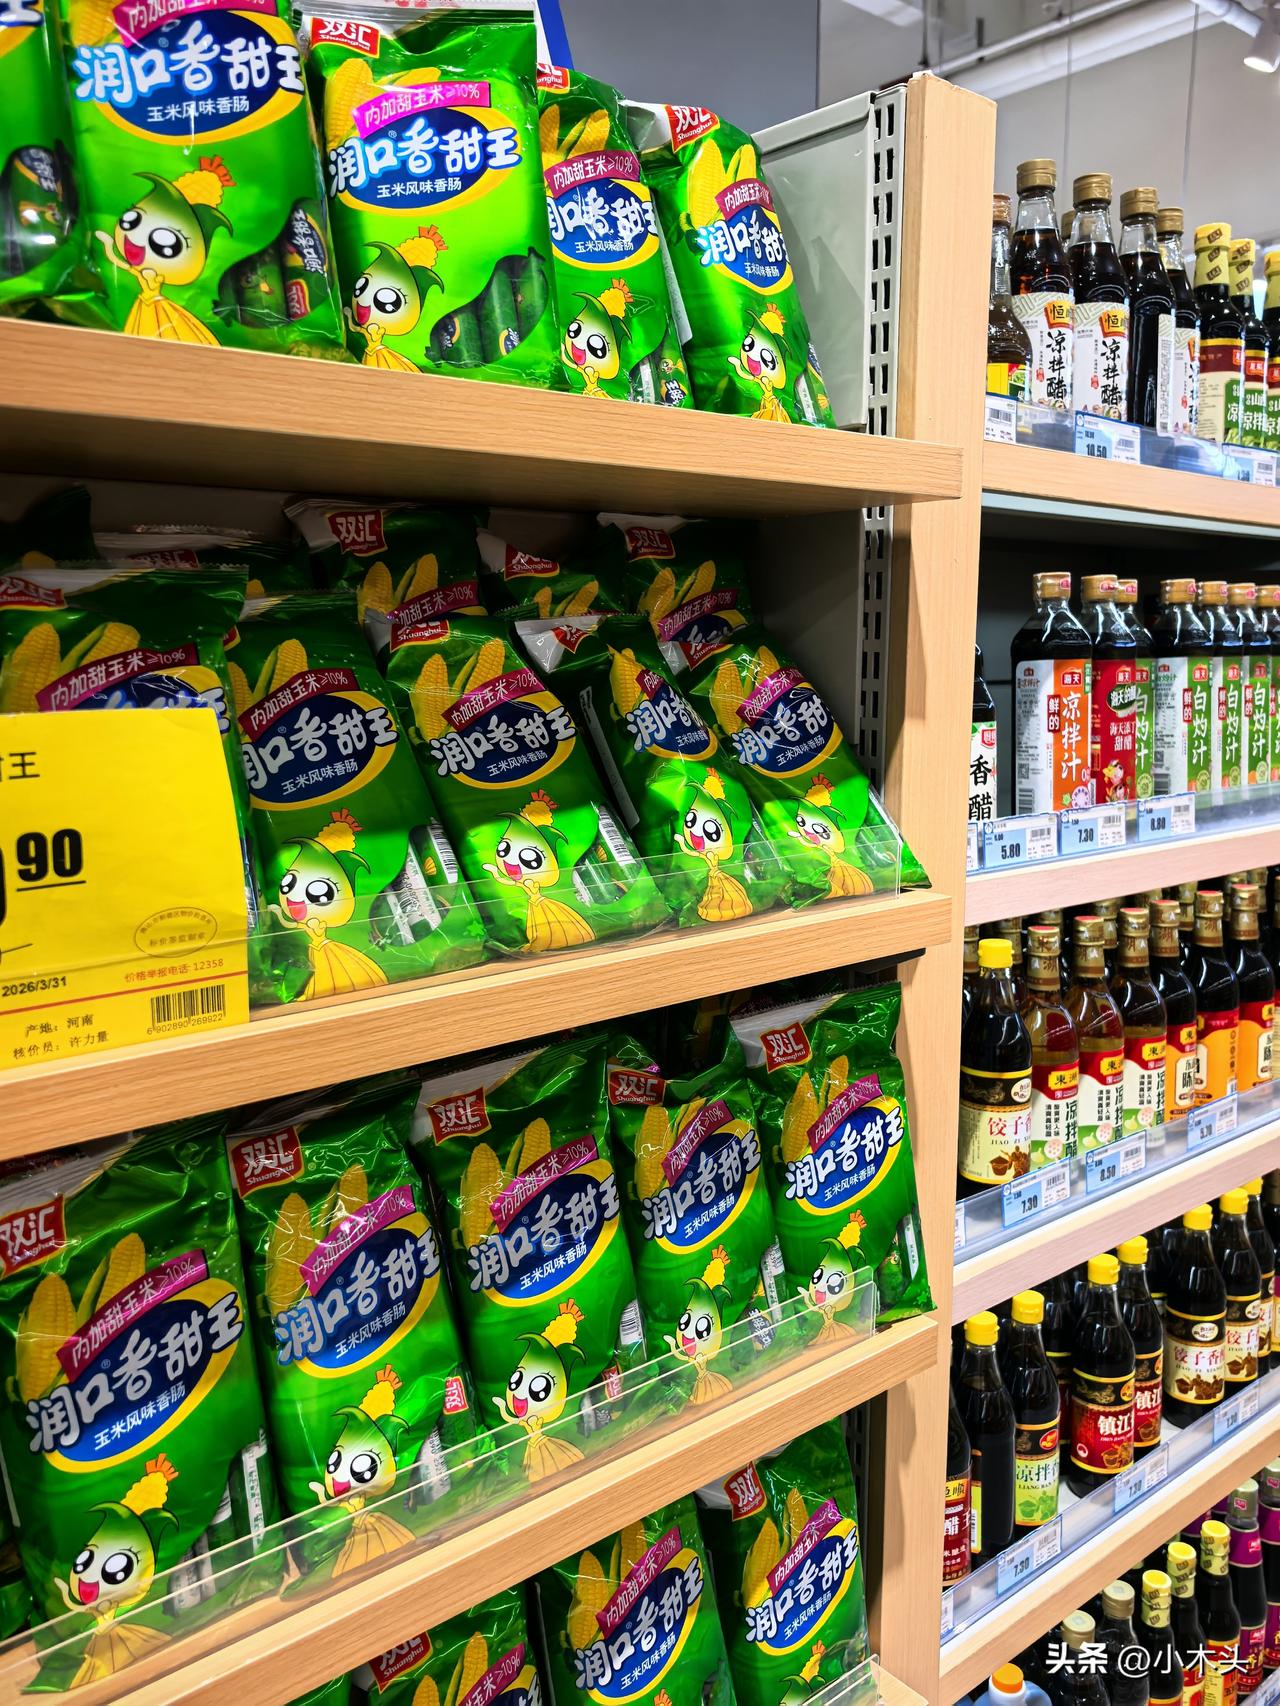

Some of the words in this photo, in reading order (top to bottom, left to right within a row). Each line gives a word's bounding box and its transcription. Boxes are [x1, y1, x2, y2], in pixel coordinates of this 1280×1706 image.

[319, 18, 371, 46] 双汇
[75, 20, 304, 103] 润口香甜王
[147, 96, 250, 123] 玉米风味香肠
[674, 105, 711, 133] 双汇
[677, 120, 712, 142] Shuanghui
[329, 117, 522, 197] 润口香甜王
[553, 157, 634, 190] 内加甜玉米≥10%
[377, 177, 462, 199] 玉米风味香肠
[574, 239, 634, 254] 玉米风味香肠
[697, 210, 790, 265] 润口香甜
[744, 262, 780, 278] 玉米风味香肠
[1045, 329, 1068, 400] 凉拌醋
[1100, 338, 1122, 406] 凉拌醋
[335, 513, 377, 544] 双汇
[633, 529, 667, 548] 双汇
[398, 625, 442, 641] Shuanghui
[51, 651, 187, 712] 内加甜玉米≥10%
[250, 671, 349, 732] 内加甜玉米≥10%
[452, 672, 538, 726] 内加甜玉米≥10%
[732, 694, 830, 766] 润口香甜
[1048, 696, 1060, 731] 鲜的
[1192, 685, 1208, 767] 白灼汁
[1225, 683, 1239, 763] 白灼汁
[1252, 682, 1266, 759] 白灼汁
[431, 706, 577, 777] 润口香甜王
[775, 734, 825, 767] 玉米风味香肠
[1060, 691, 1082, 782] 凉拌汁
[0, 751, 40, 781] 王
[280, 757, 359, 796] 玉米风味香肠
[486, 750, 548, 777] 玉米风味香肠
[968, 754, 992, 821] 香醋
[1001, 843, 1021, 860] 5.80
[1078, 828, 1094, 844] 7.30
[2, 976, 67, 997] 2026/3/31
[124, 964, 190, 983] 价格举报电话
[193, 959, 224, 972] 12358
[66, 1014, 94, 1028] 河南
[146, 1027, 153, 1036] 6
[156, 1019, 188, 1034] 902890
[191, 1013, 223, 1028] 269922
[767, 1028, 803, 1058] 双汇
[616, 1075, 657, 1097] 双汇
[434, 1096, 480, 1128] 双汇
[441, 1122, 482, 1135] Shuanghui
[241, 1133, 294, 1178] 双汇
[785, 1106, 904, 1199] 润口香甜王
[1100, 1164, 1116, 1182] 8.50
[246, 1163, 295, 1186] Shuanghui
[500, 1141, 589, 1221] 内加甜玉米≥10%
[641, 1130, 762, 1239] 润口香甜王
[824, 1163, 876, 1202] 玉米风味香肠
[683, 1192, 735, 1239] 玉米风味香肠
[1021, 1195, 1038, 1214] 7.30
[468, 1172, 620, 1291] 润口香甜王
[519, 1242, 588, 1291] 玉米风味香肠
[71, 1258, 196, 1368] 内加甜玉米≥10%
[275, 1228, 441, 1364] 润口香甜王
[335, 1300, 407, 1360] 玉米风味香肠
[26, 1292, 244, 1452] 润口香甜王
[93, 1383, 187, 1451] 玉米风味香肠
[732, 1467, 761, 1509] 双汇
[606, 1534, 676, 1630] 内加甜玉米≥10%
[746, 1527, 858, 1642] 润口香甜王
[1013, 1557, 1030, 1578] 7.30
[575, 1557, 703, 1690] 润口香甜王
[784, 1592, 832, 1641] 玉米风味香肠
[383, 1645, 425, 1678] Shuanghui
[620, 1632, 676, 1691] 玉米风味香肠
